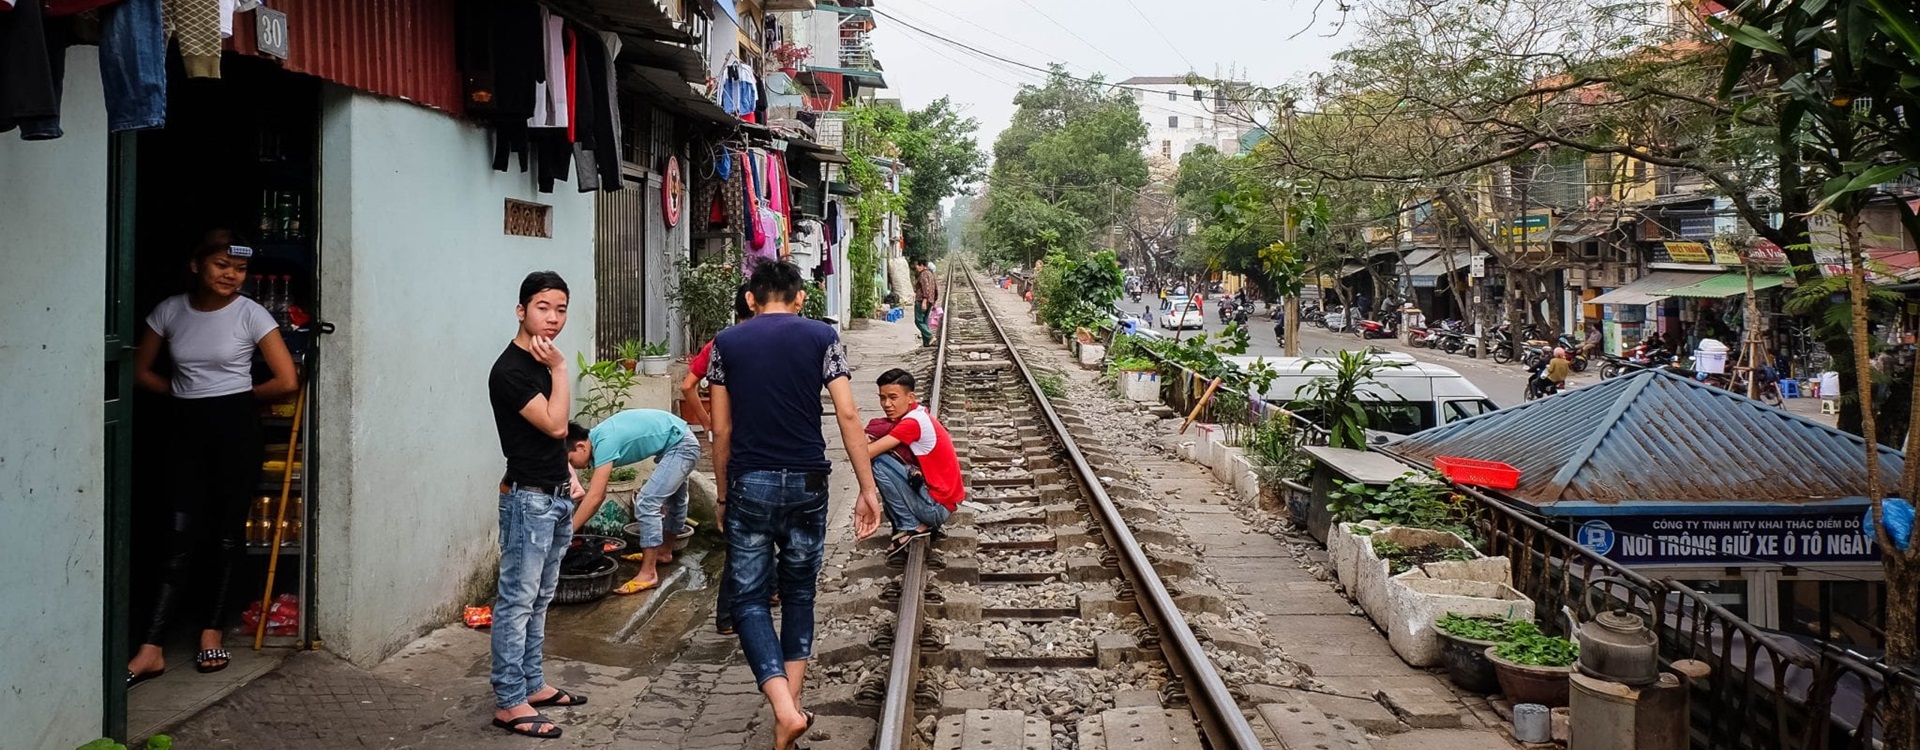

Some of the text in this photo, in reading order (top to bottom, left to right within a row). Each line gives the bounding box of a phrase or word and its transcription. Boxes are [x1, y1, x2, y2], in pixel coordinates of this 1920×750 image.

[262, 15, 281, 48] 30
[1653, 519, 1683, 529] CÔNG
[1686, 520, 1699, 529] TY
[1702, 520, 1730, 529] TNHH
[1733, 520, 1755, 529] MTV
[1758, 520, 1783, 529] KHAI
[1786, 518, 1814, 529] THÁC
[1658, 531, 1717, 556] TRÔNG
[1721, 530, 1754, 556] GIỮ
[1756, 535, 1779, 556] XE
[1784, 531, 1796, 556] Ô
[1801, 531, 1822, 556] TÔ
[1827, 530, 1874, 556] NGÀY
